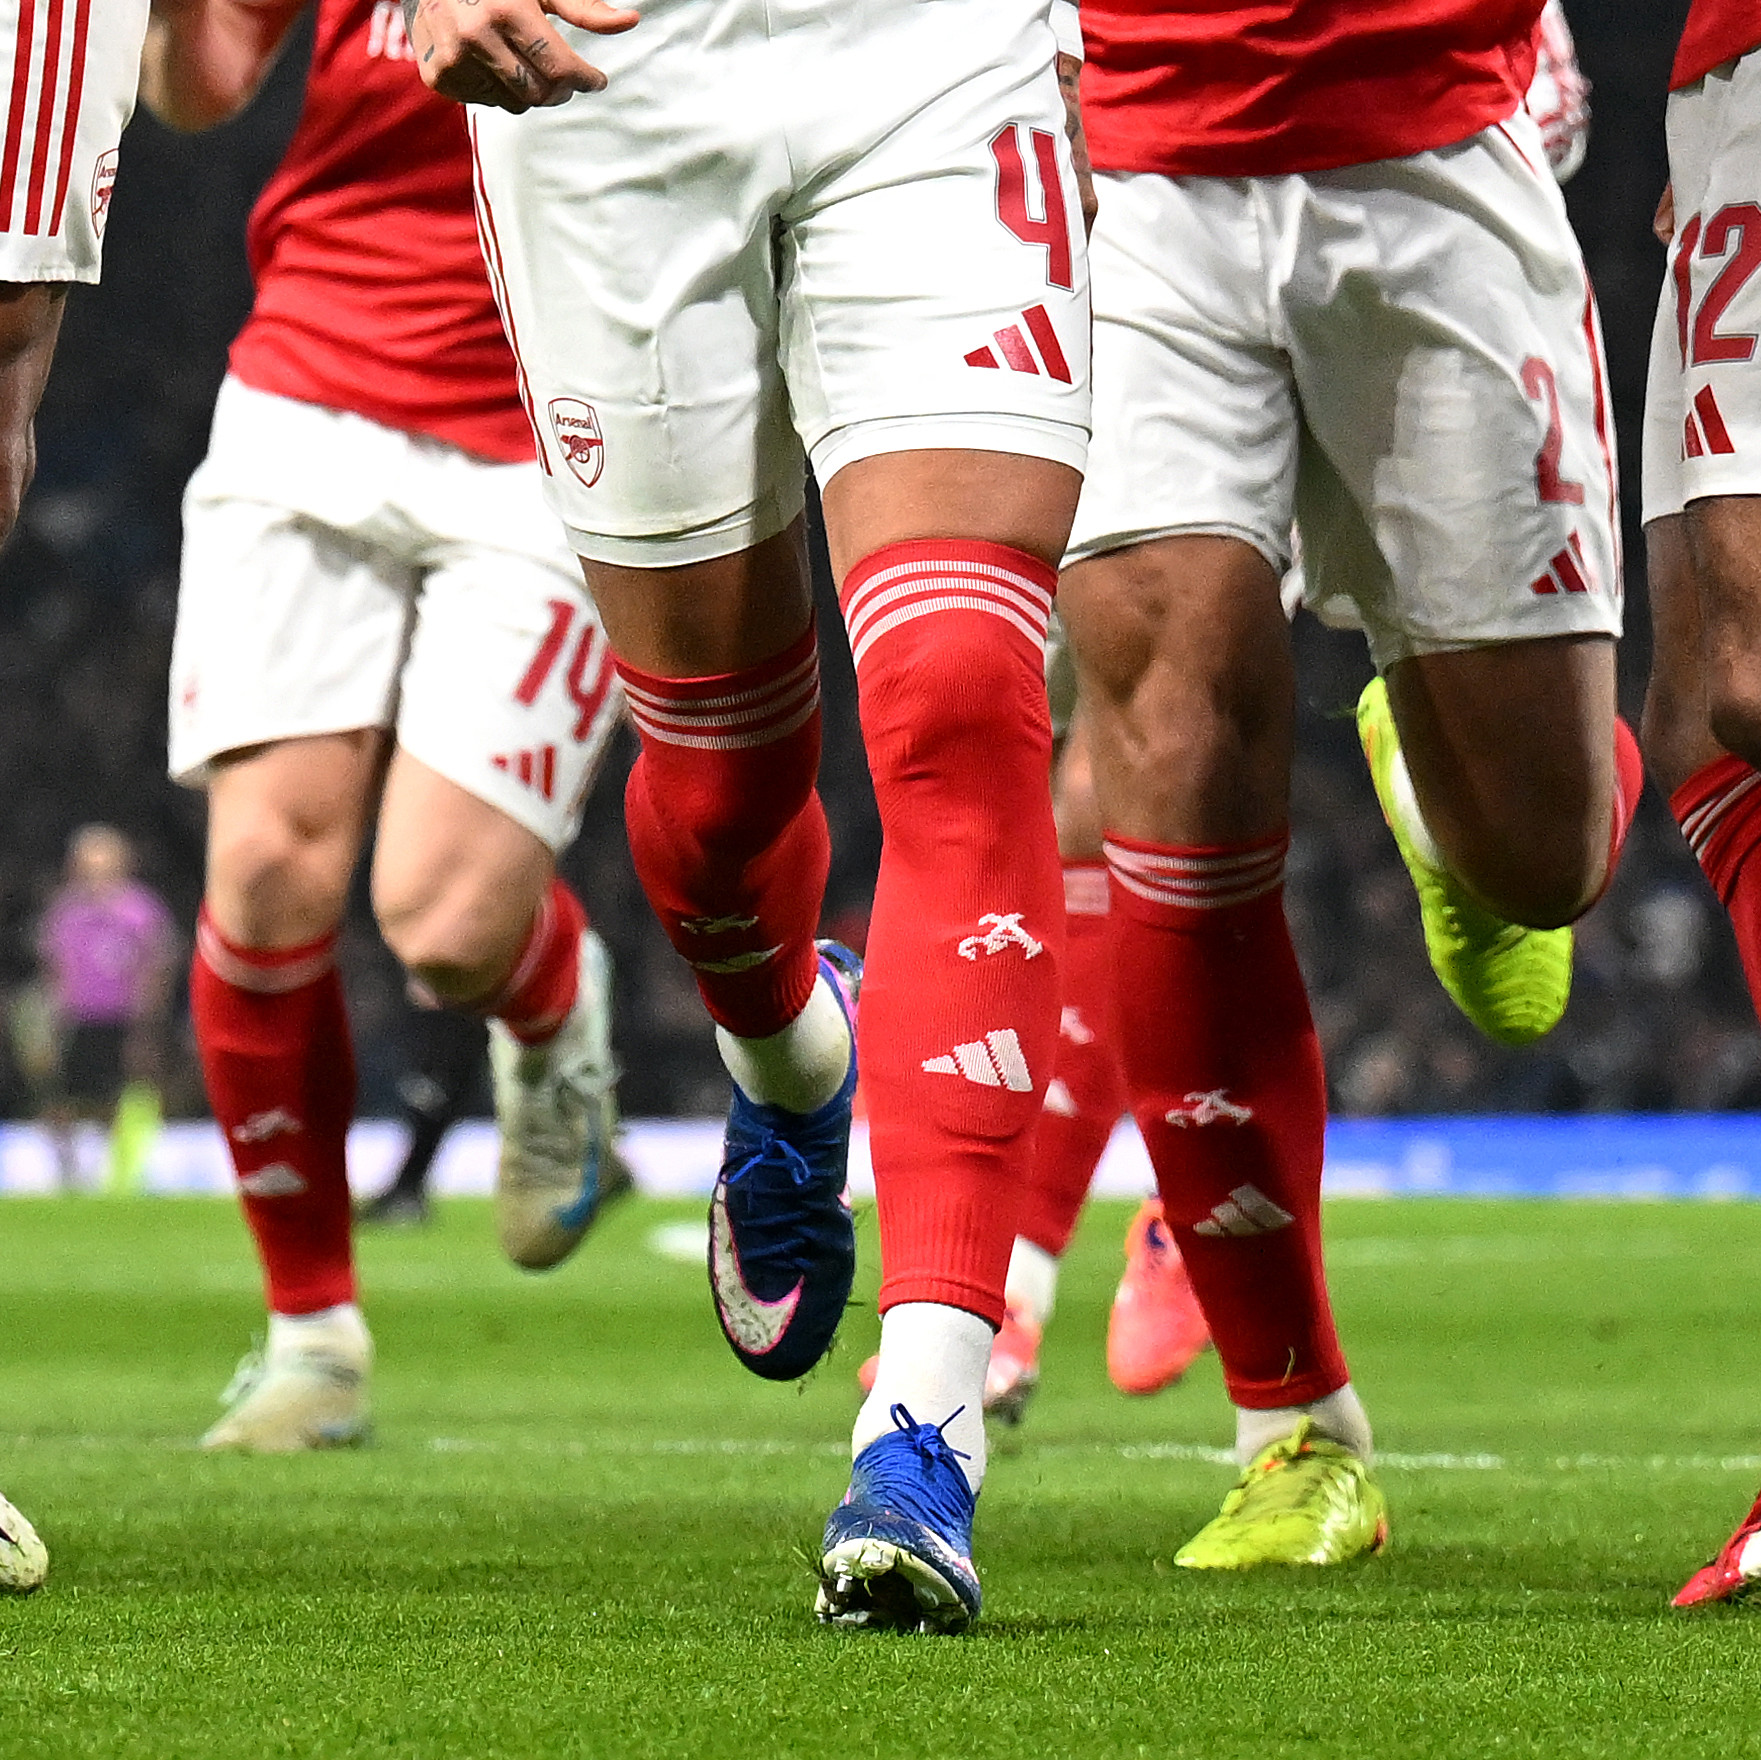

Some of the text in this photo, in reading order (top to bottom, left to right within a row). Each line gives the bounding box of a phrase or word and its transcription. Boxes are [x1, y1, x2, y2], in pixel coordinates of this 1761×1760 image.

[987, 121, 1075, 293] 4
[555, 412, 593, 430] Arsenal
[512, 596, 618, 743] 14
